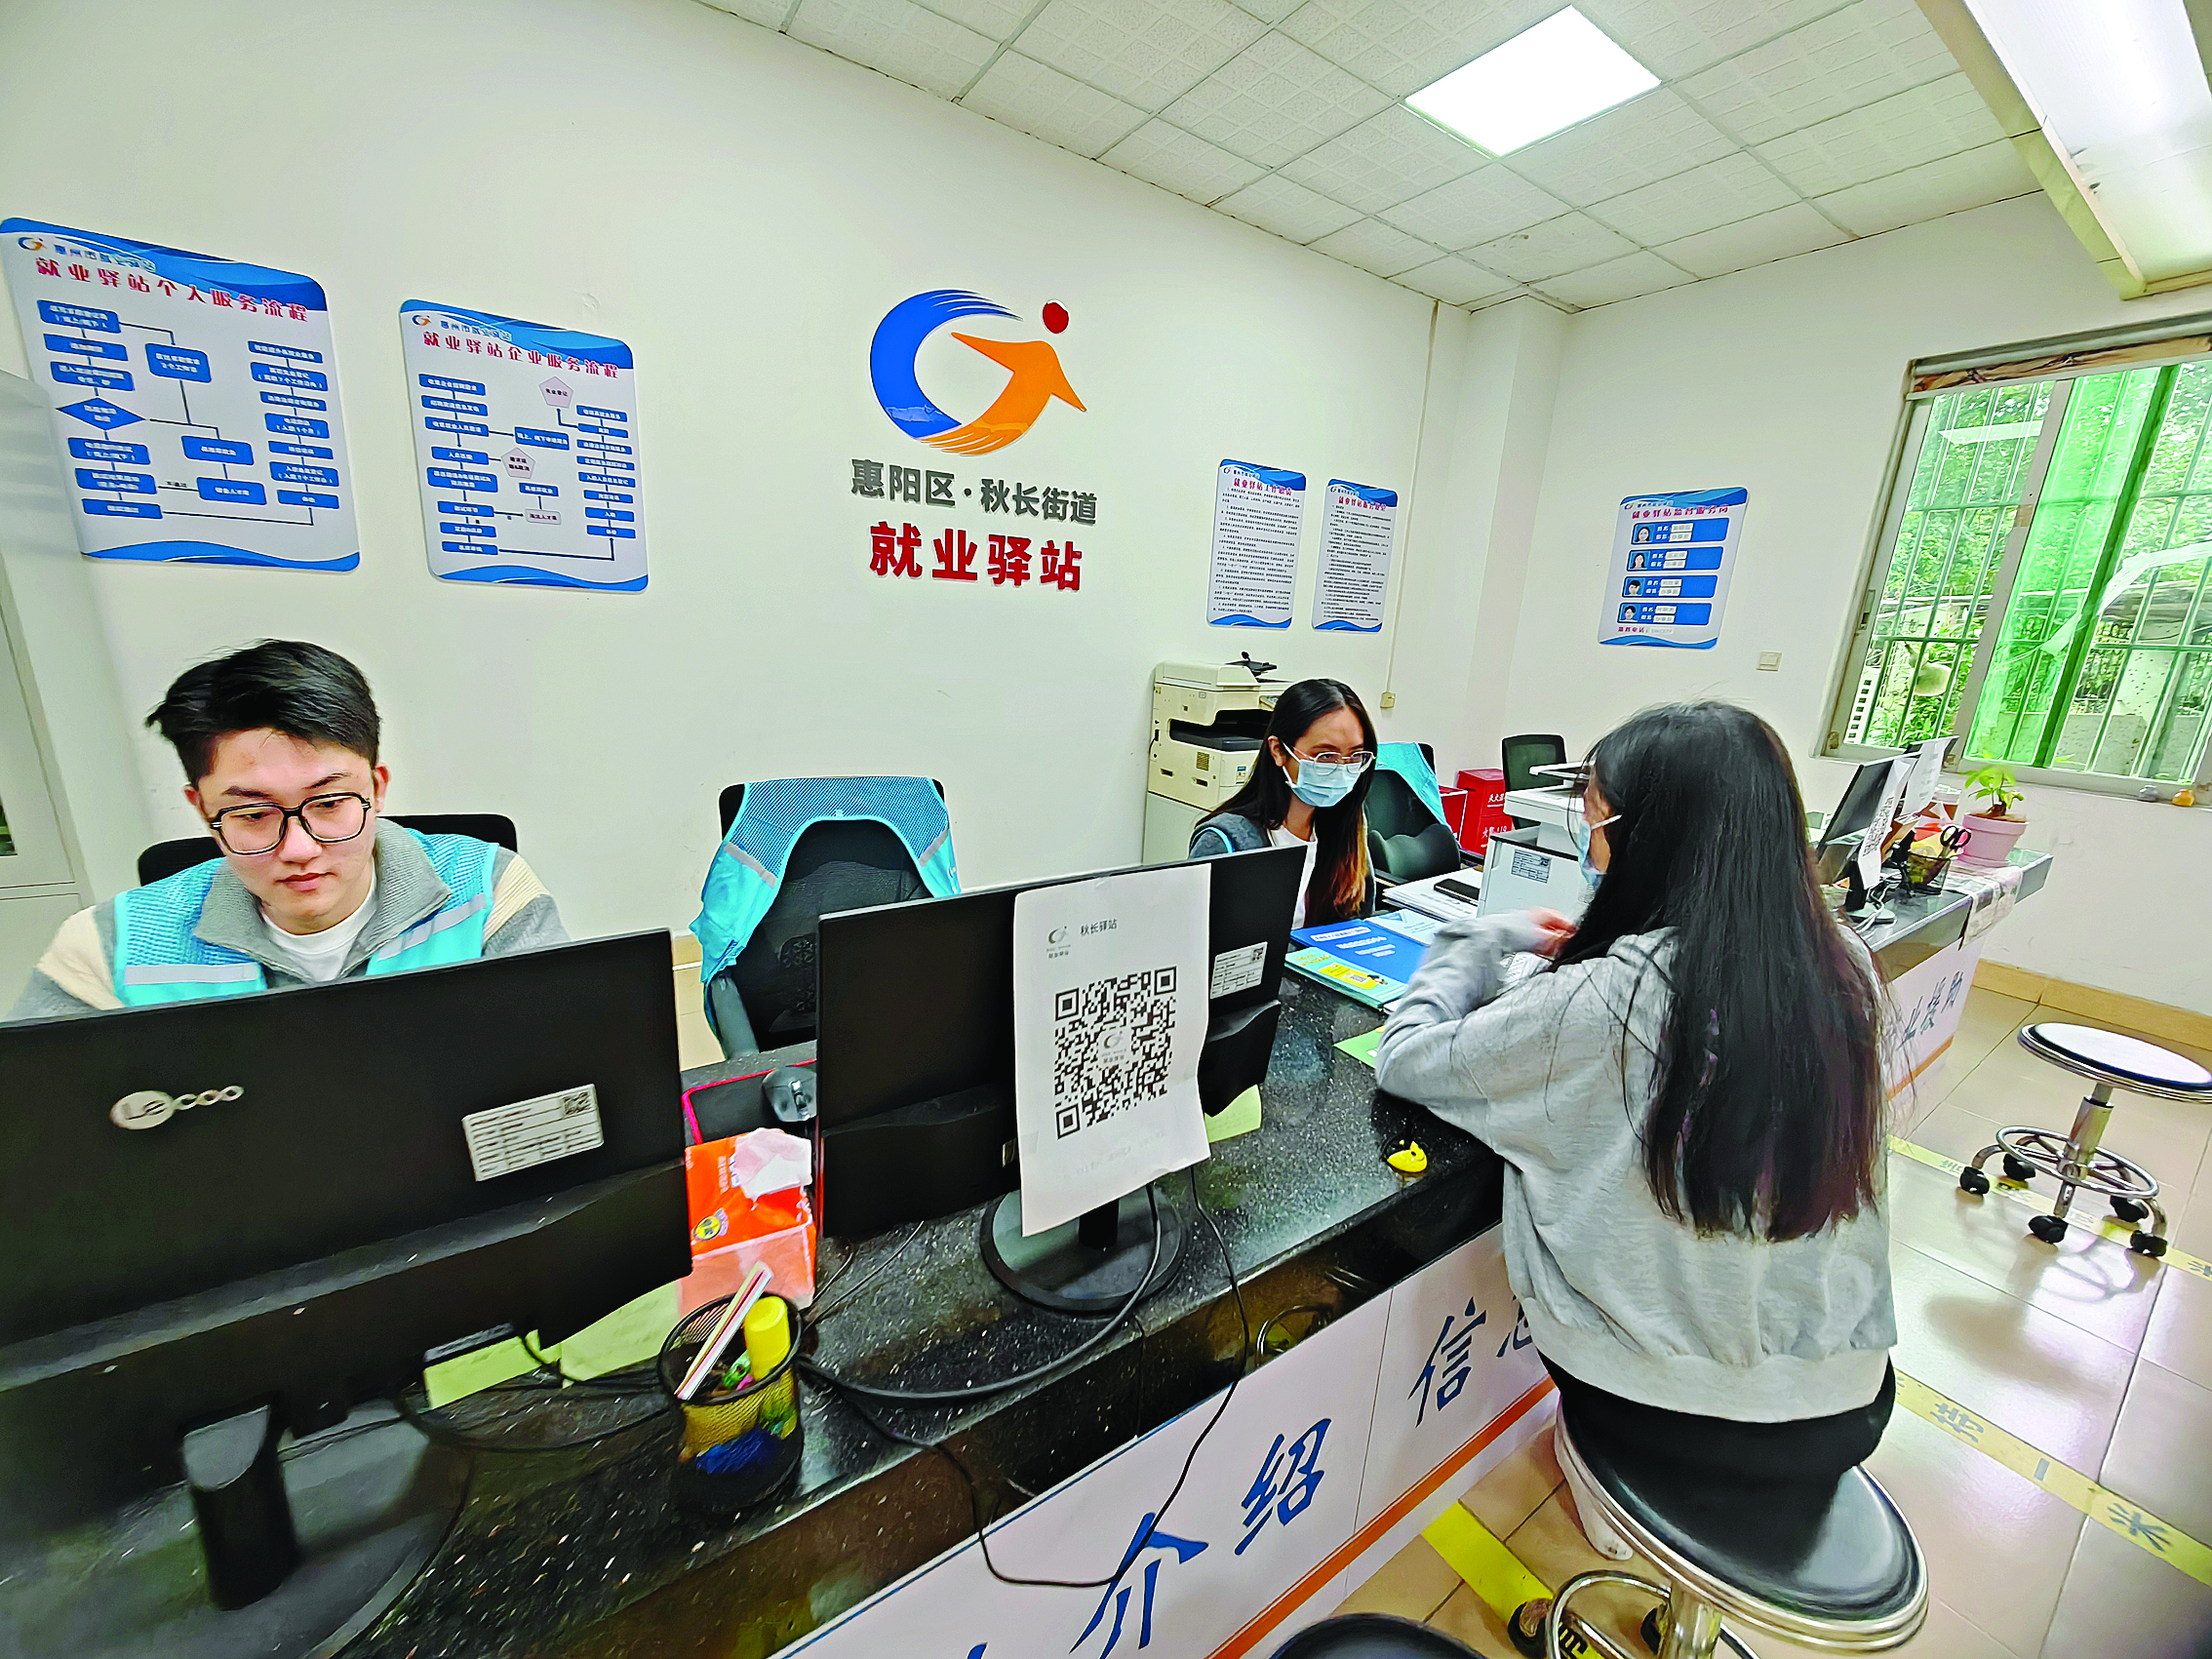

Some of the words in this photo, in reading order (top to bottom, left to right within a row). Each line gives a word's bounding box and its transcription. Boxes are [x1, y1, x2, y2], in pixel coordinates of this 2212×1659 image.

[35, 257, 308, 323] 就业驿站个人服务流程
[423, 331, 619, 379] 就业驿站企业服务流程
[850, 458, 1098, 526] 惠阳区·秋长街道
[869, 521, 1083, 591] 就业驿站
[1080, 919, 1118, 936] 秋长驿站
